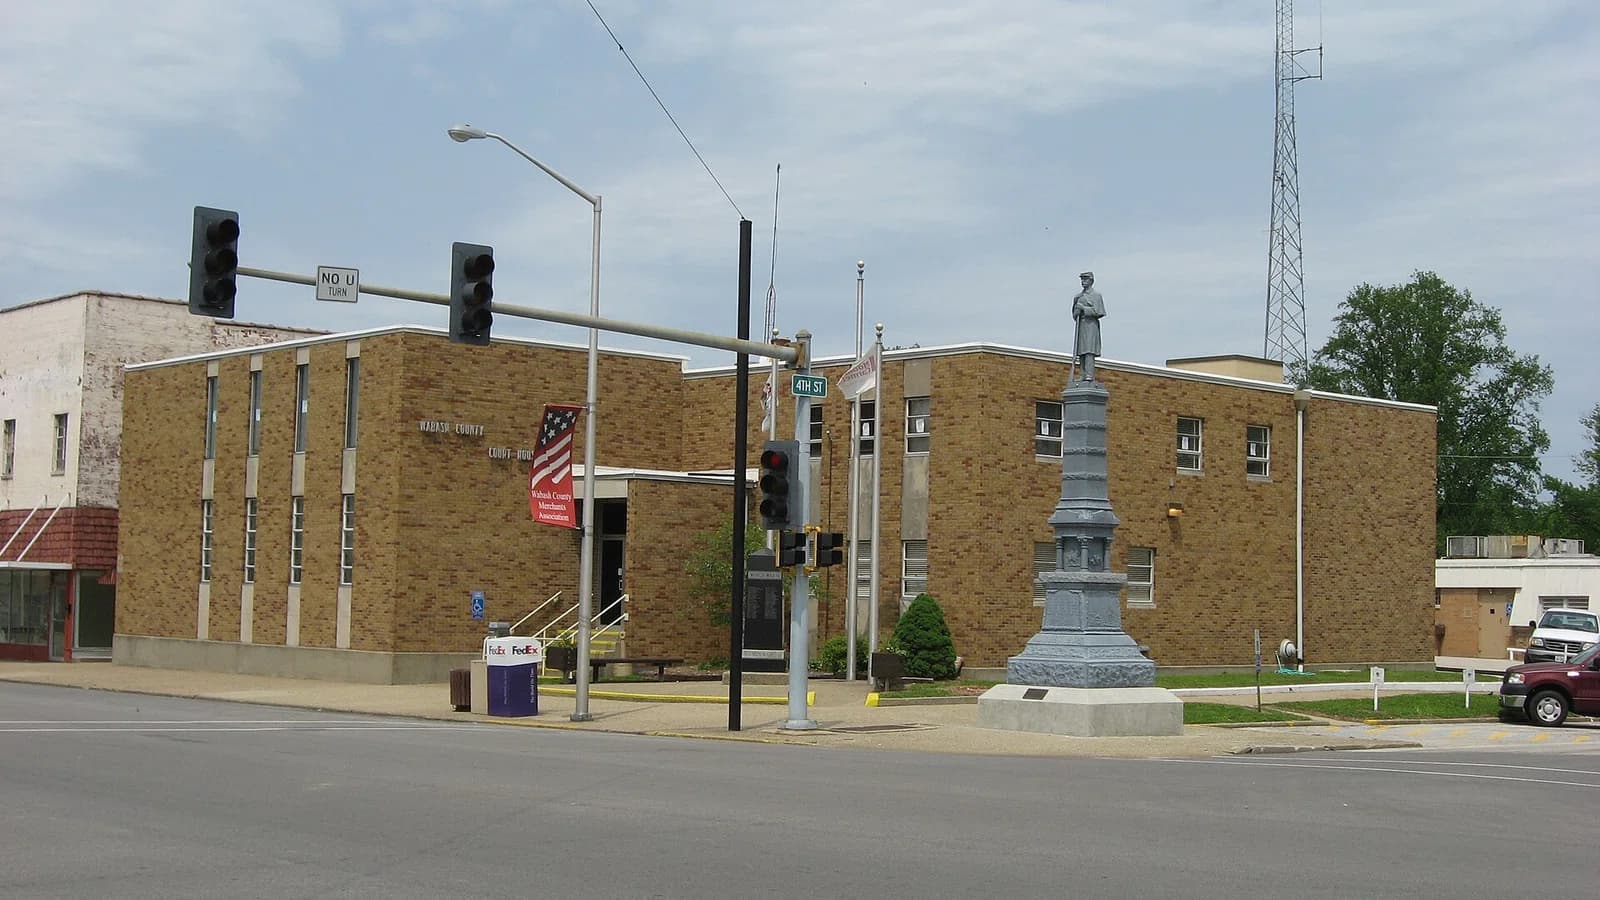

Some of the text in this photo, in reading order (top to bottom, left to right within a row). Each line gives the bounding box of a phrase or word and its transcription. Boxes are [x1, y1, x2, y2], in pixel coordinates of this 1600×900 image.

[321, 272, 355, 286] NO U
[328, 286, 348, 297] TURN
[796, 379, 823, 393] 4TH ST
[419, 421, 484, 436] WABASH COUNTY
[488, 447, 512, 460] COURT
[531, 490, 571, 502] Wabash County
[538, 501, 567, 511] Merchants
[539, 511, 570, 522] Association
[488, 645, 506, 656] FedEx
[512, 644, 538, 656] FedEx
